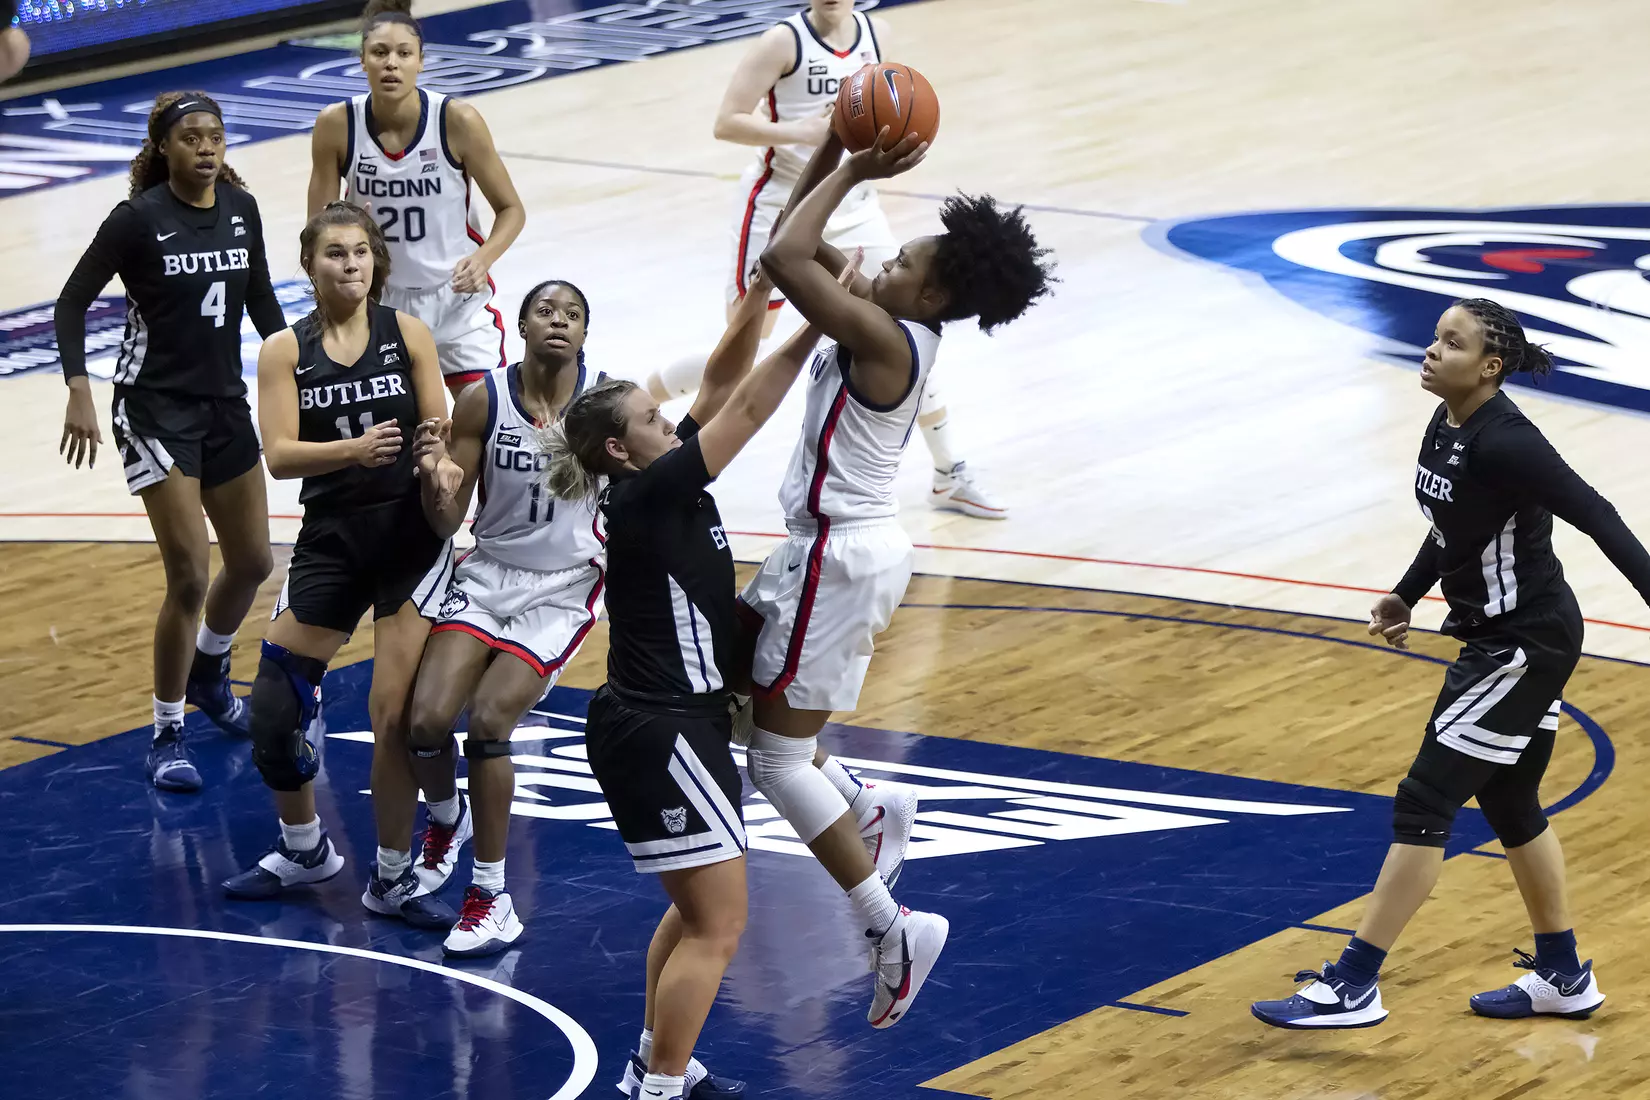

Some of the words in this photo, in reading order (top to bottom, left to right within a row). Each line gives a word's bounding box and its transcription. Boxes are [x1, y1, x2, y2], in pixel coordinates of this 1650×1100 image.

[356, 176, 442, 198] UCONN
[377, 206, 426, 242] 20
[162, 247, 250, 276] BUTLER
[201, 281, 227, 328] 4
[300, 373, 407, 410] BUTLER
[335, 411, 374, 440] 11
